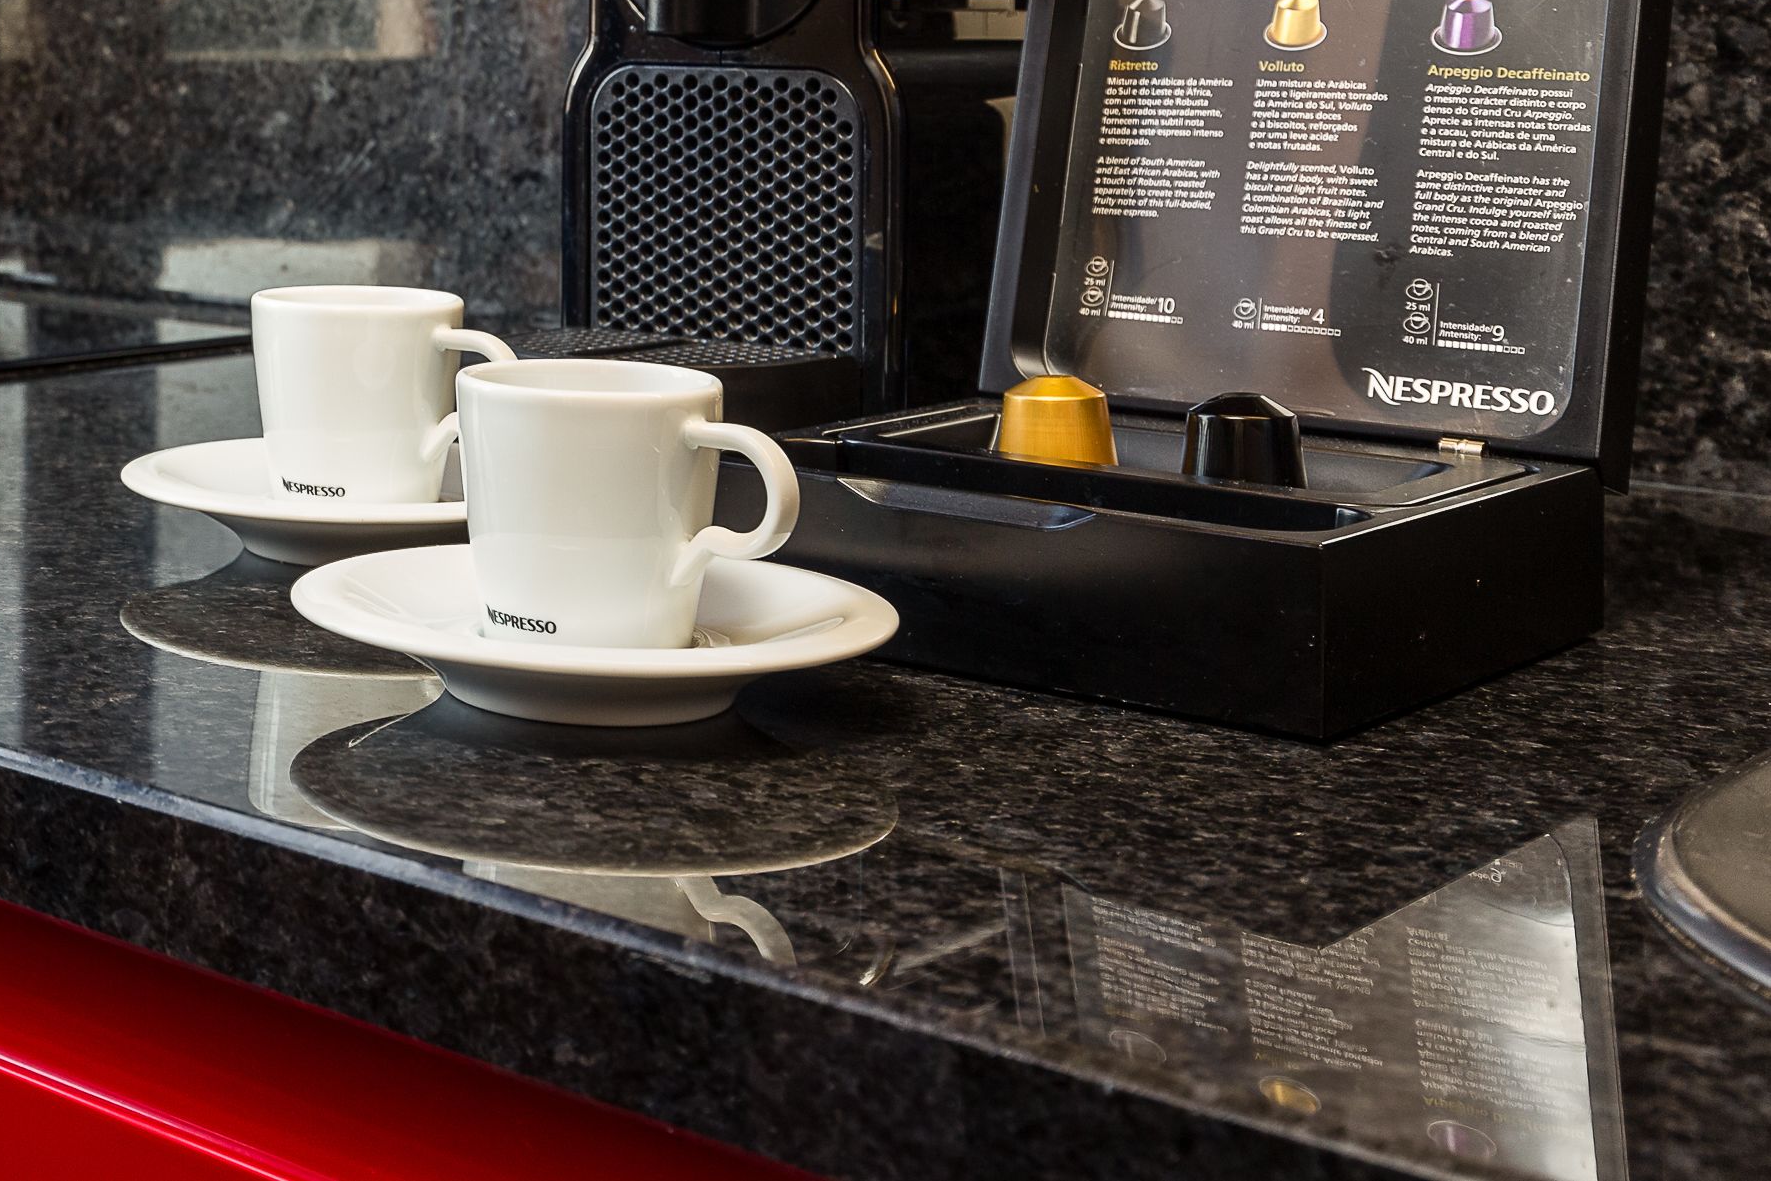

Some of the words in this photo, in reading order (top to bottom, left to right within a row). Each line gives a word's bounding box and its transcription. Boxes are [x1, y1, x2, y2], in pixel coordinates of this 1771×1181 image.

[1110, 59, 1158, 70] Ristretto
[1259, 60, 1304, 72] Volluto
[1428, 65, 1492, 80] Arpeggio
[1497, 67, 1589, 81] Decaffeinato
[1256, 78, 1277, 87] Uma
[1278, 79, 1312, 88] mistura
[1313, 79, 1326, 88] de
[1254, 90, 1280, 98] puros
[1289, 89, 1346, 102] ligeiramente
[1348, 91, 1388, 101] torrados
[1425, 83, 1472, 95] Arpeggio
[1473, 85, 1538, 96] Decaffeinato
[1540, 88, 1573, 98] possui
[1253, 99, 1265, 107] da
[1304, 100, 1318, 109] do
[1338, 101, 1372, 111] Volluto
[1433, 96, 1467, 104] mesmo
[1509, 97, 1547, 107] distinto
[1547, 100, 1555, 108] e
[1556, 101, 1586, 110] corpo
[1252, 109, 1279, 119] revela
[1280, 111, 1314, 119] aromas
[1315, 111, 1341, 120] doces
[1423, 105, 1453, 114] denso
[1454, 106, 1468, 115] do
[1470, 106, 1501, 116] Grand
[1503, 108, 1521, 117] Cru
[1422, 116, 1460, 126] Aprecie
[1474, 118, 1515, 128] intensas
[1517, 121, 1545, 129] notas
[1547, 122, 1591, 131] torradas
[1249, 131, 1266, 140] por
[1289, 131, 1308, 140] leve
[1309, 132, 1338, 141] acidez
[1470, 129, 1514, 139] oriundas
[1516, 131, 1530, 139] de
[1532, 133, 1555, 142] uma
[1256, 141, 1281, 149] notas
[1420, 137, 1457, 147] mistura
[1458, 139, 1472, 148] de
[1518, 142, 1532, 151] da
[1418, 147, 1454, 157] Central
[1465, 150, 1479, 159] do
[1246, 161, 1299, 173] Delightfully
[1339, 165, 1374, 175] Volluto
[1245, 171, 1261, 180] has
[1269, 173, 1298, 182] round
[1326, 175, 1348, 184] with
[1349, 178, 1378, 186] sweet
[1416, 169, 1463, 183] Arpeggio
[1465, 172, 1530, 184] Decaffeinato
[1532, 176, 1550, 185] has
[1552, 177, 1570, 186] the
[1244, 182, 1273, 191] biscuit
[1274, 184, 1293, 192] and
[1293, 184, 1315, 196] light
[1317, 185, 1338, 195] fruit
[1443, 182, 1493, 193] distinctive
[1495, 185, 1543, 196] character
[1544, 188, 1566, 197] and
[1243, 193, 1251, 201] A
[1252, 194, 1308, 204] combination
[1309, 196, 1321, 204] of
[1321, 197, 1362, 207] Brazilian
[1363, 200, 1384, 208] and
[1414, 191, 1432, 199] full
[1432, 192, 1459, 204] body
[1473, 194, 1491, 204] the
[1492, 196, 1533, 207] original
[1533, 198, 1583, 211] Arpeggio
[1242, 203, 1289, 213] Colombian
[1334, 208, 1346, 217] its
[1347, 209, 1370, 220] light
[1413, 201, 1445, 211] Grand
[1468, 205, 1507, 217] Indulge
[1508, 209, 1551, 218] yourself
[1552, 210, 1576, 220] with
[1241, 215, 1263, 223] roast
[1264, 215, 1293, 225] allows
[1294, 217, 1307, 225] all
[1308, 218, 1324, 227] the
[1325, 218, 1357, 229] finesse
[1358, 221, 1372, 229] of
[1412, 213, 1429, 221] the
[1431, 214, 1467, 224] intense
[1469, 218, 1498, 226] cocoa
[1500, 219, 1521, 228] and
[1522, 221, 1562, 230] roasted
[1240, 225, 1256, 234] this
[1257, 226, 1286, 235] Grand
[1286, 227, 1303, 236] Cru
[1304, 229, 1315, 237] to
[1316, 229, 1329, 238] be
[1443, 227, 1480, 238] coming
[1483, 228, 1508, 238] from
[1509, 231, 1516, 239] a
[1518, 230, 1549, 241] blend
[1550, 233, 1564, 242] of
[1410, 234, 1447, 244] Central
[1447, 238, 1469, 246] and
[1469, 238, 1499, 248] South
[1501, 241, 1550, 252] American
[1158, 297, 1175, 314] 10
[1405, 302, 1416, 310] 25
[1419, 302, 1430, 311] ml
[1311, 308, 1325, 324] 4
[1491, 325, 1504, 341] 9
[1402, 336, 1414, 344] 40
[1416, 337, 1428, 345] ml
[1361, 367, 1555, 416] NESPRESSO
[281, 476, 346, 497] NESPRESSO
[485, 603, 557, 634] NESPRESSO
